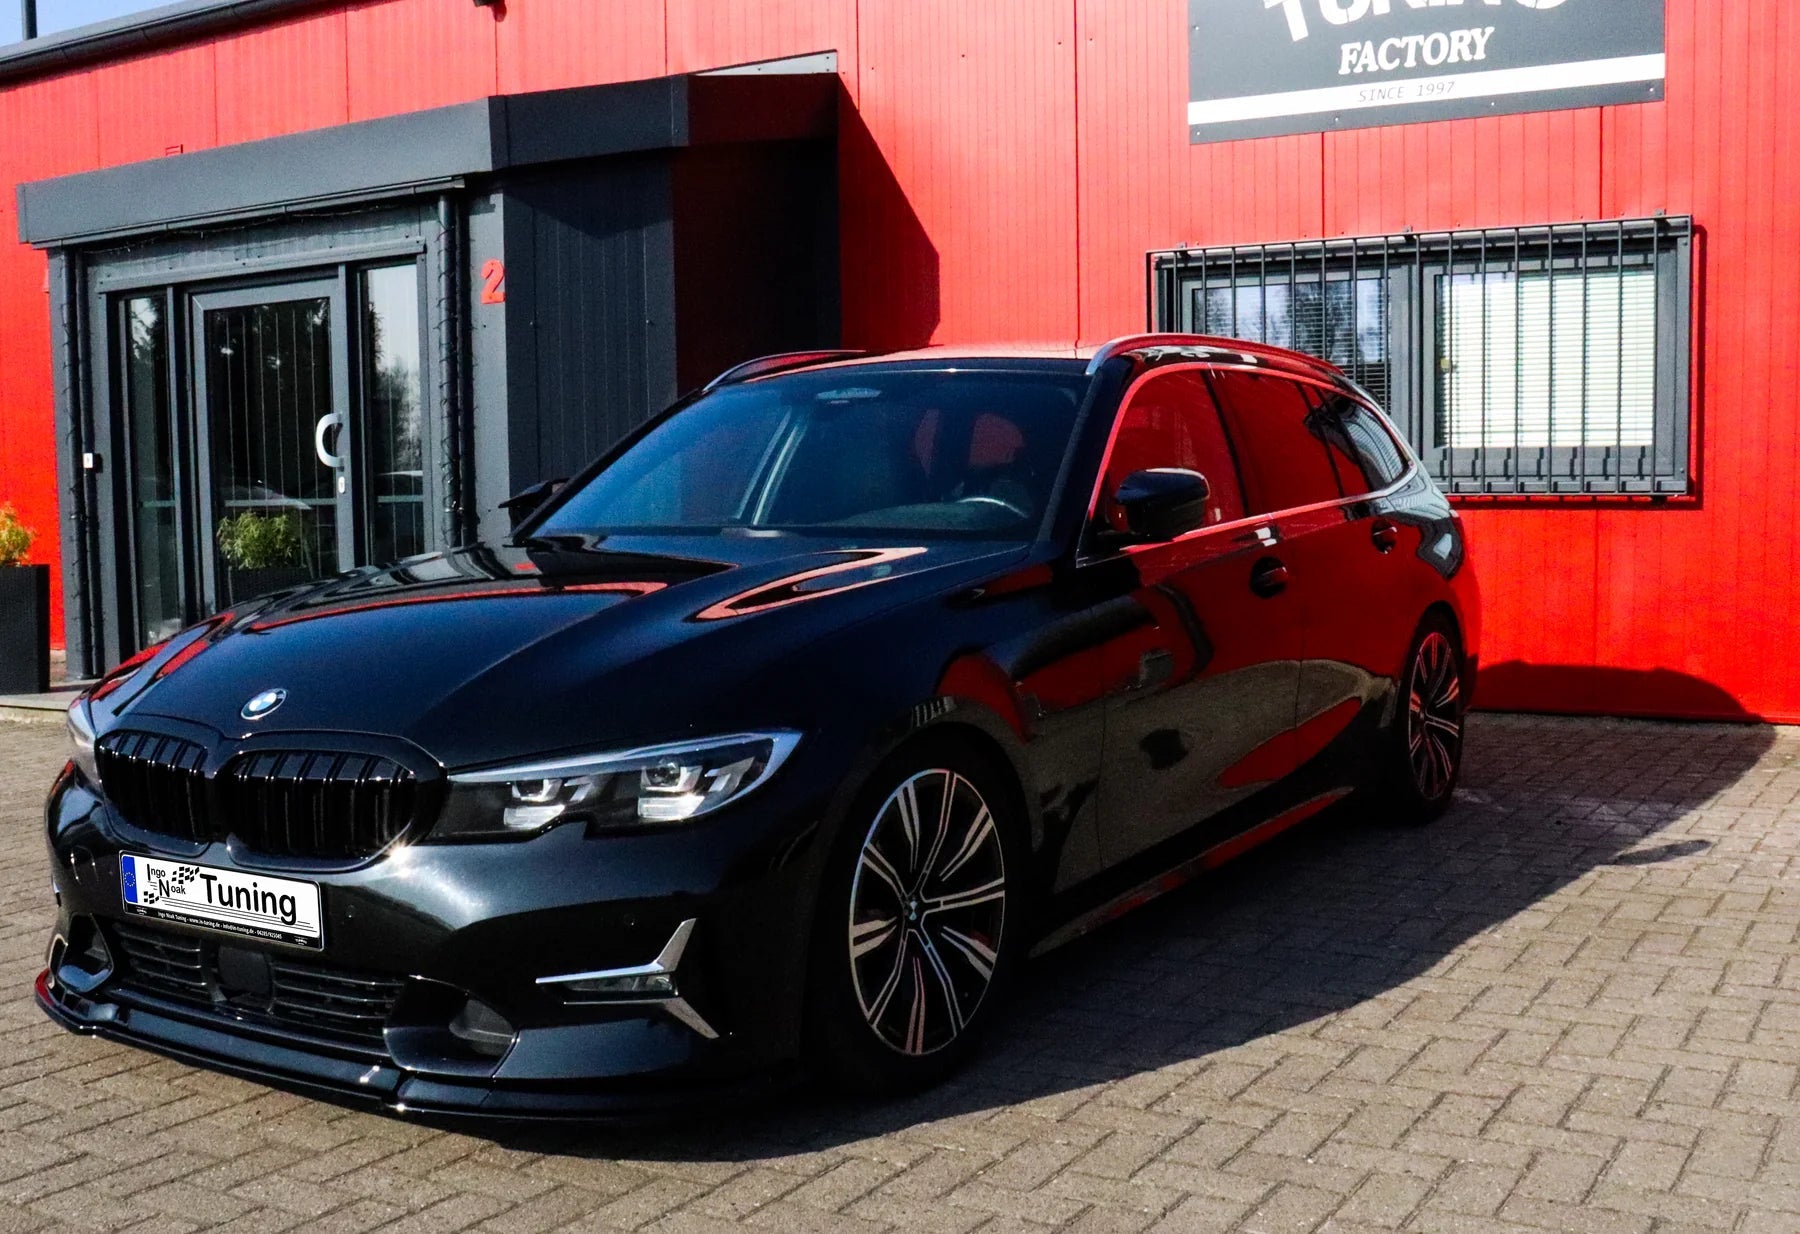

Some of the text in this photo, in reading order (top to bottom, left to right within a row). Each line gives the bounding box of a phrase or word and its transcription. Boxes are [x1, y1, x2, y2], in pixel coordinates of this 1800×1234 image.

[1338, 26, 1495, 75] FACTORY
[1358, 81, 1455, 102] SINCE 1997
[481, 251, 506, 304] 2
[147, 864, 166, 881] Ingo
[159, 879, 186, 897] Noak
[200, 874, 296, 925] Tuning
